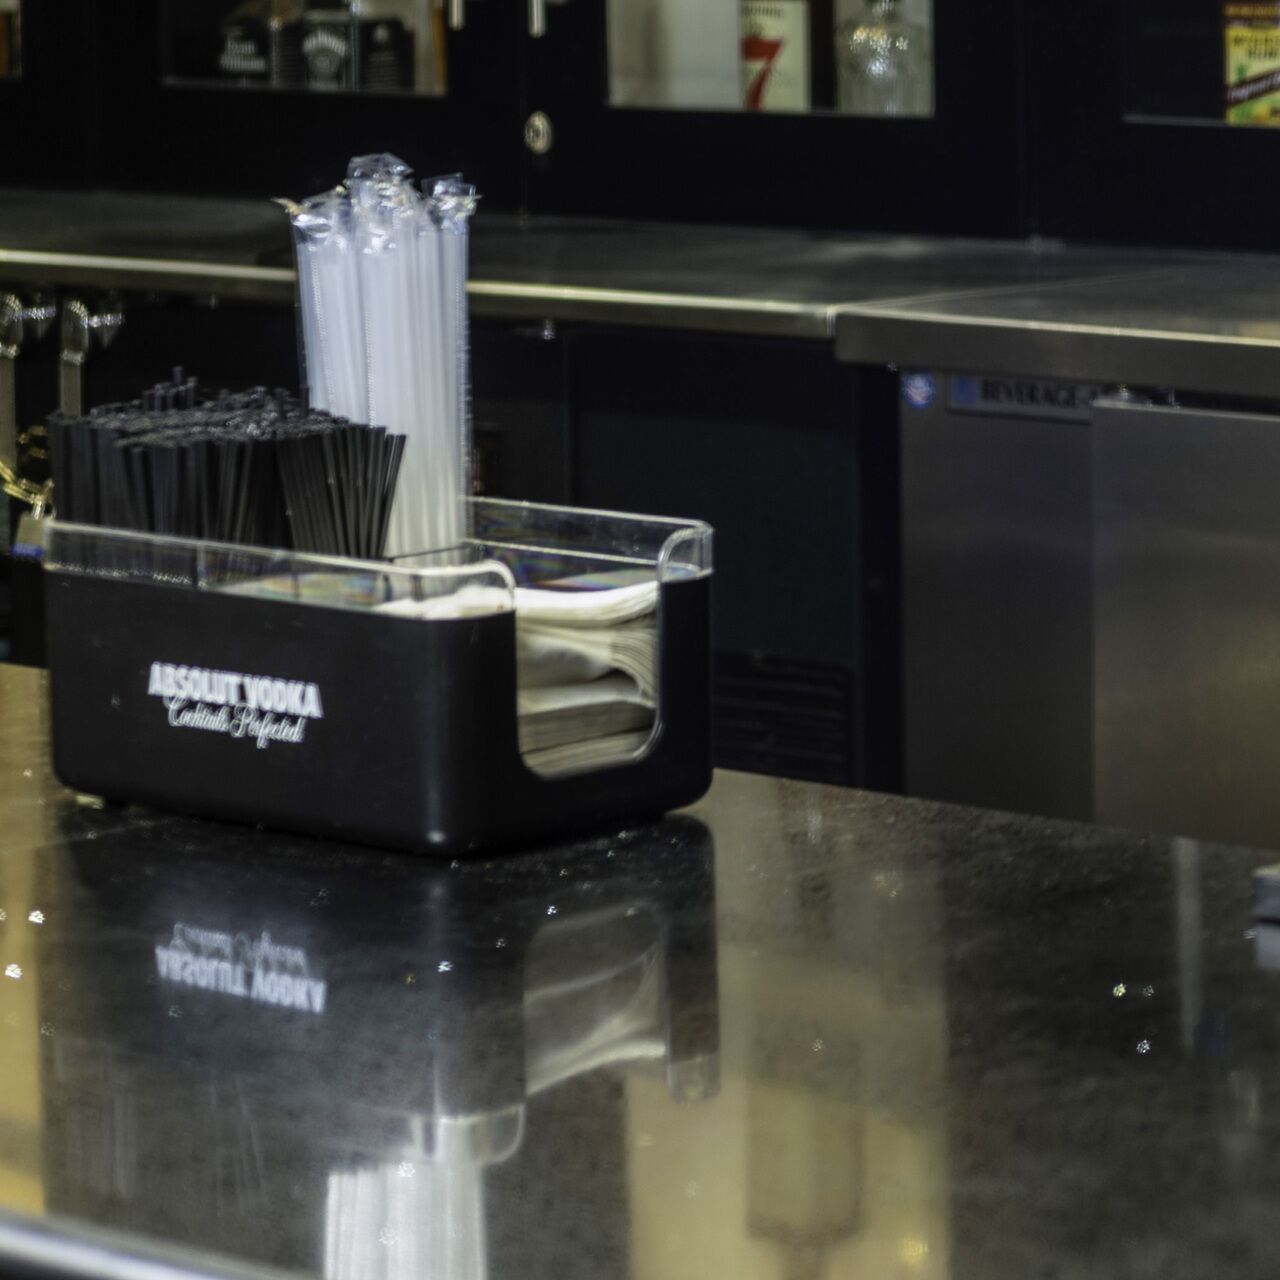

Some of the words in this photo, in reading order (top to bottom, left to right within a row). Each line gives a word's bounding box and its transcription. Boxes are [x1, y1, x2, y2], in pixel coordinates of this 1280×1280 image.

[148, 661, 242, 706] ABSOLUT
[243, 674, 324, 718] VODKA
[230, 702, 308, 750] Perfected
